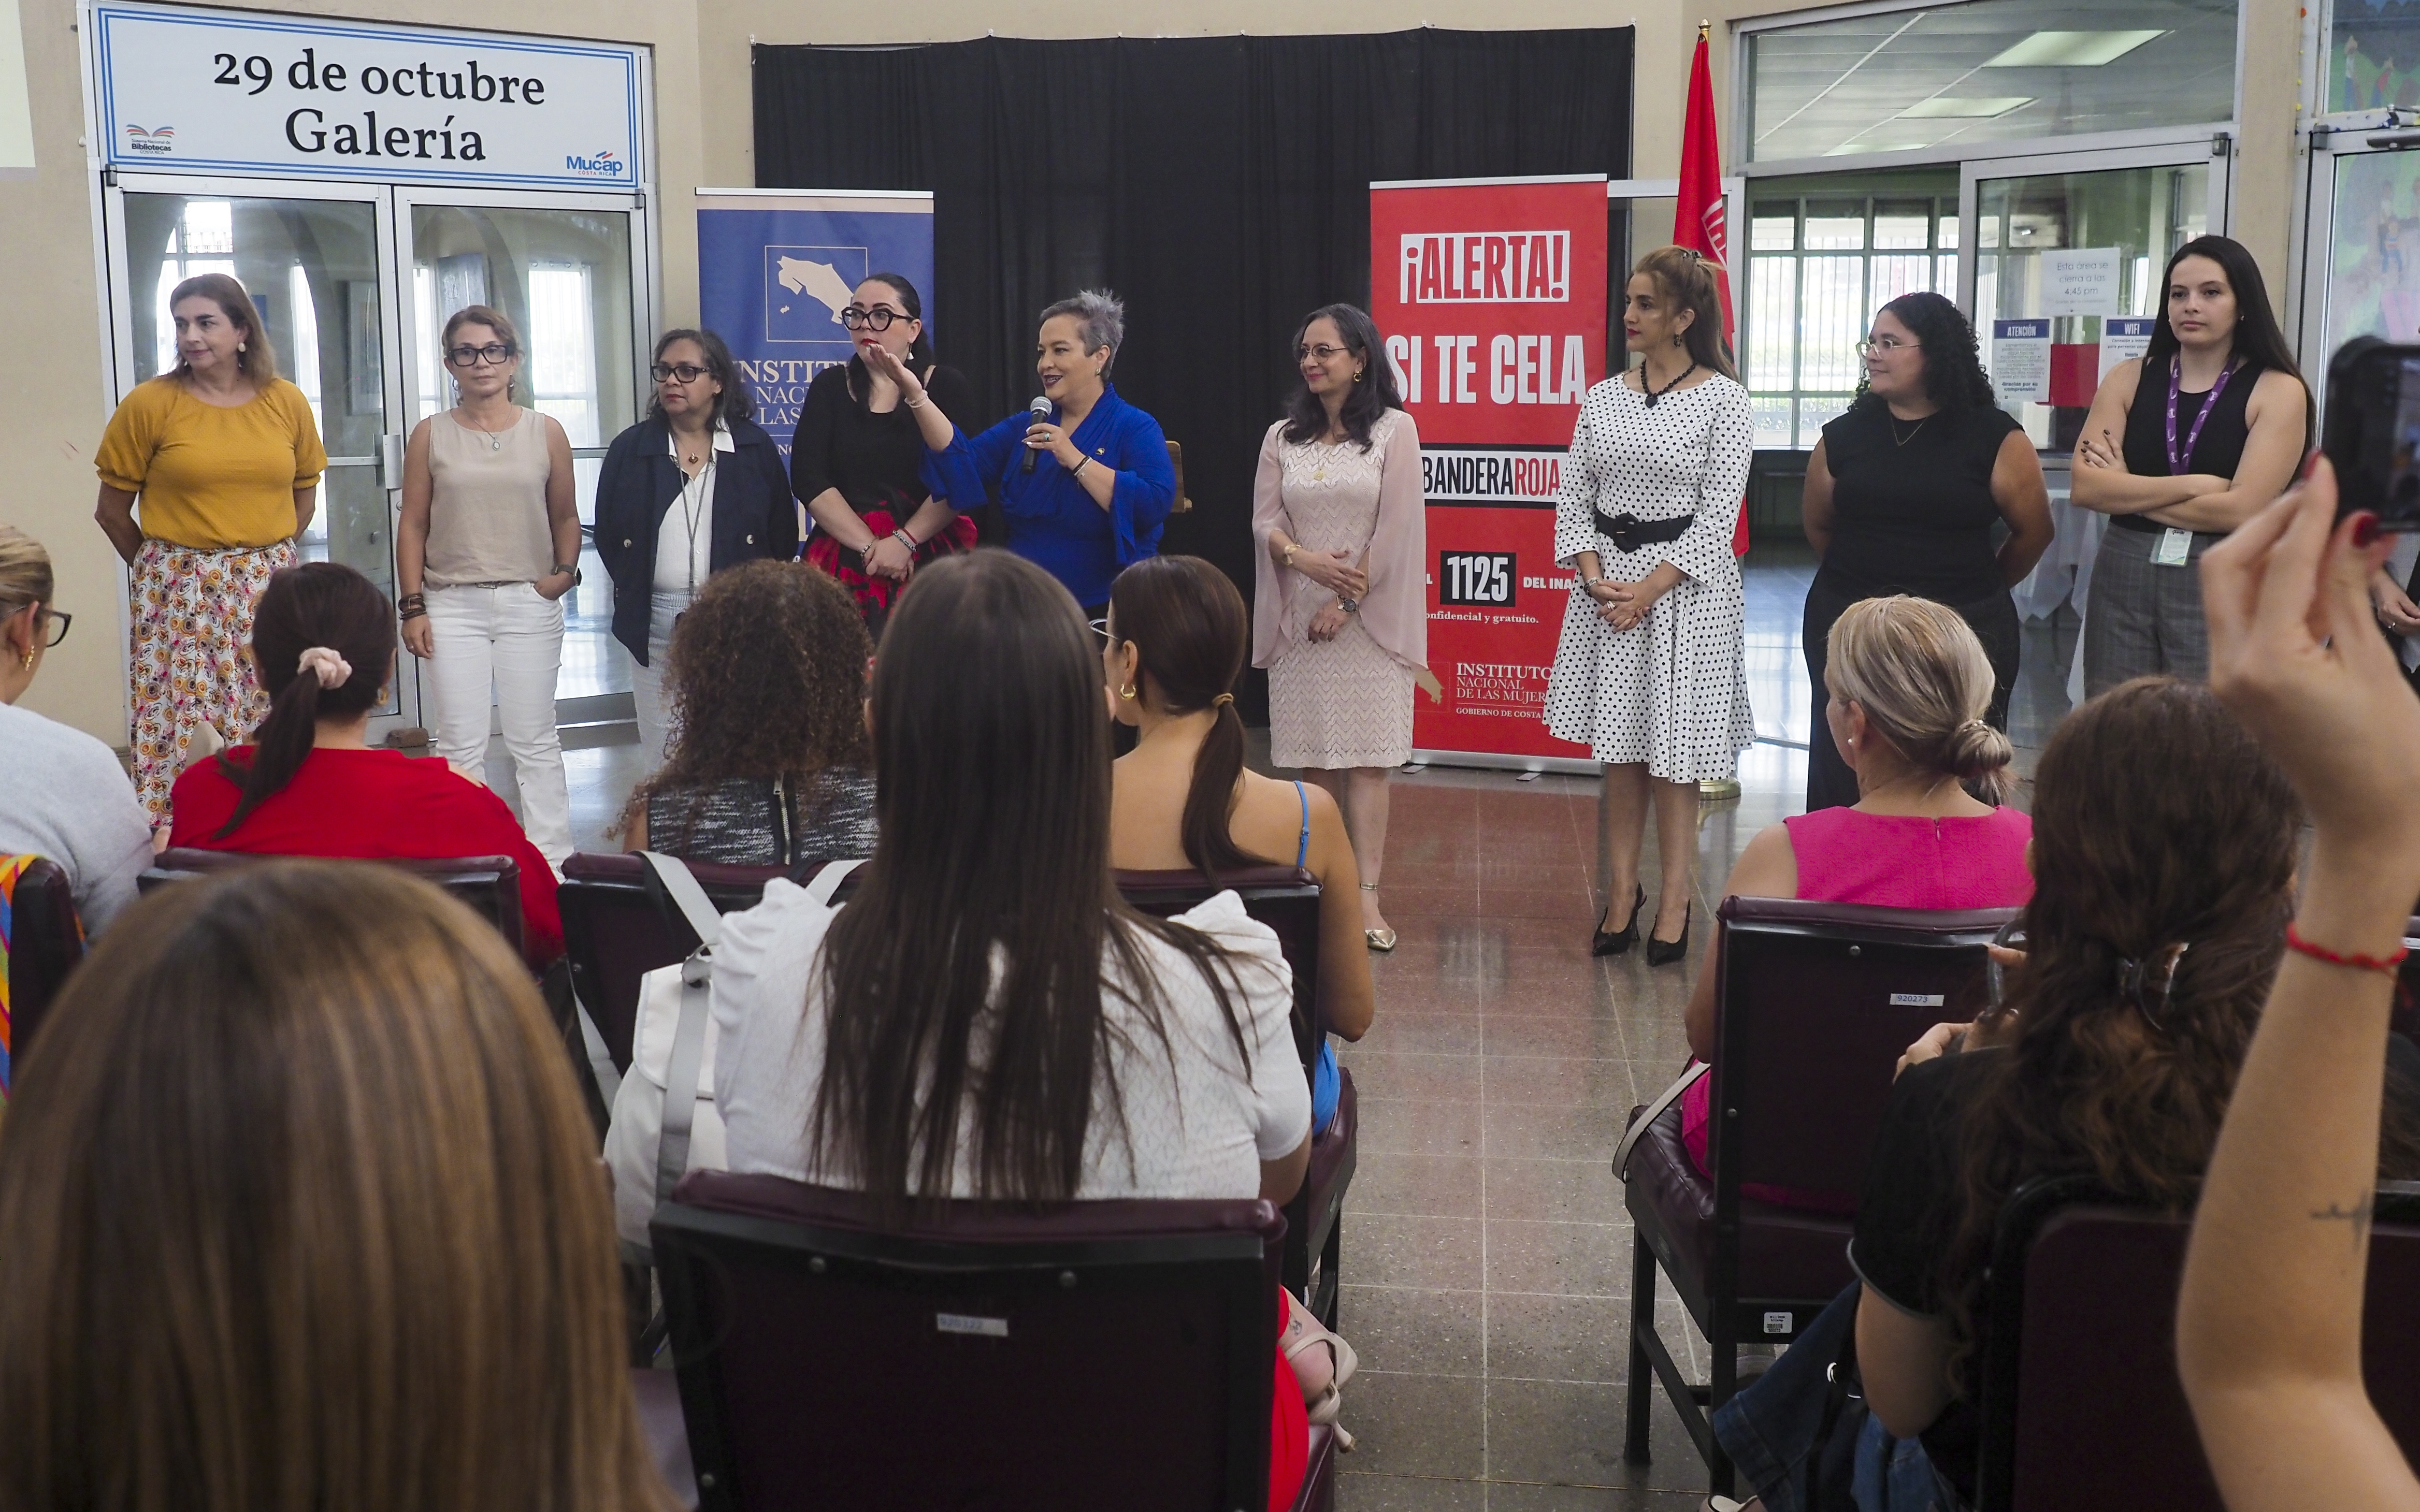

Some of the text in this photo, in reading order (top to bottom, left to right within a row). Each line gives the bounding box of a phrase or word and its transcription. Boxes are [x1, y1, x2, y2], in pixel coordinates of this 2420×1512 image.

[214, 48, 544, 105] 29 de octubre
[286, 108, 486, 161] Galería
[132, 143, 172, 151] Bibliotecas
[566, 155, 623, 176] Mucap
[1407, 235, 1563, 303] ¡ALERTA!
[2057, 263, 2073, 271] Esta
[2077, 261, 2096, 270] área
[2084, 287, 2098, 296] pm
[2007, 324, 2036, 337] ATENCIÓN
[2124, 324, 2140, 335] WIFI
[1386, 335, 1586, 404] SI TE CELA
[759, 407, 801, 425] LAS
[1447, 556, 1508, 602] 1125
[1523, 577, 1546, 589] DEL
[1549, 578, 1572, 589] INA
[1426, 611, 1539, 624] onfidencial y gratuito.
[1457, 663, 1552, 680] INSTITUTO
[1457, 677, 1524, 690] NACIONAL
[1457, 688, 1546, 704] DE LAS MUJER
[1456, 707, 1500, 716] GOBIERNO
[1897, 995, 1928, 1003] 920273
